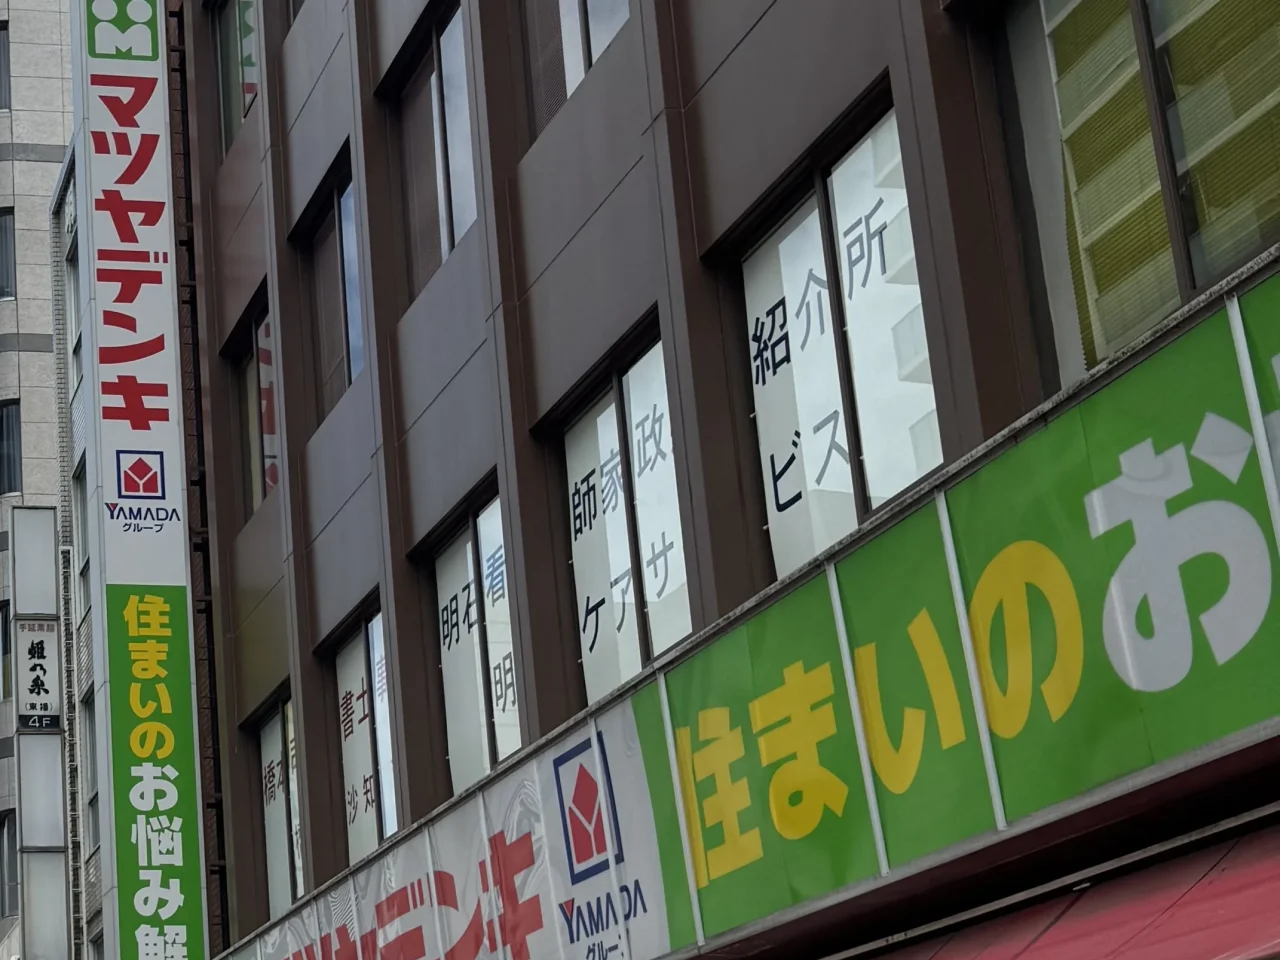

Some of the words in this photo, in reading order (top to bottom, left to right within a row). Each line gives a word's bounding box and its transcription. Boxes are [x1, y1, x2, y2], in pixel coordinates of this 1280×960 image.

[90, 73, 169, 431] マツヤデンキ
[104, 502, 180, 522] YAMADA
[122, 522, 164, 533] グループ
[28, 715, 51, 728] 4F
[559, 879, 647, 944] YAMADA
